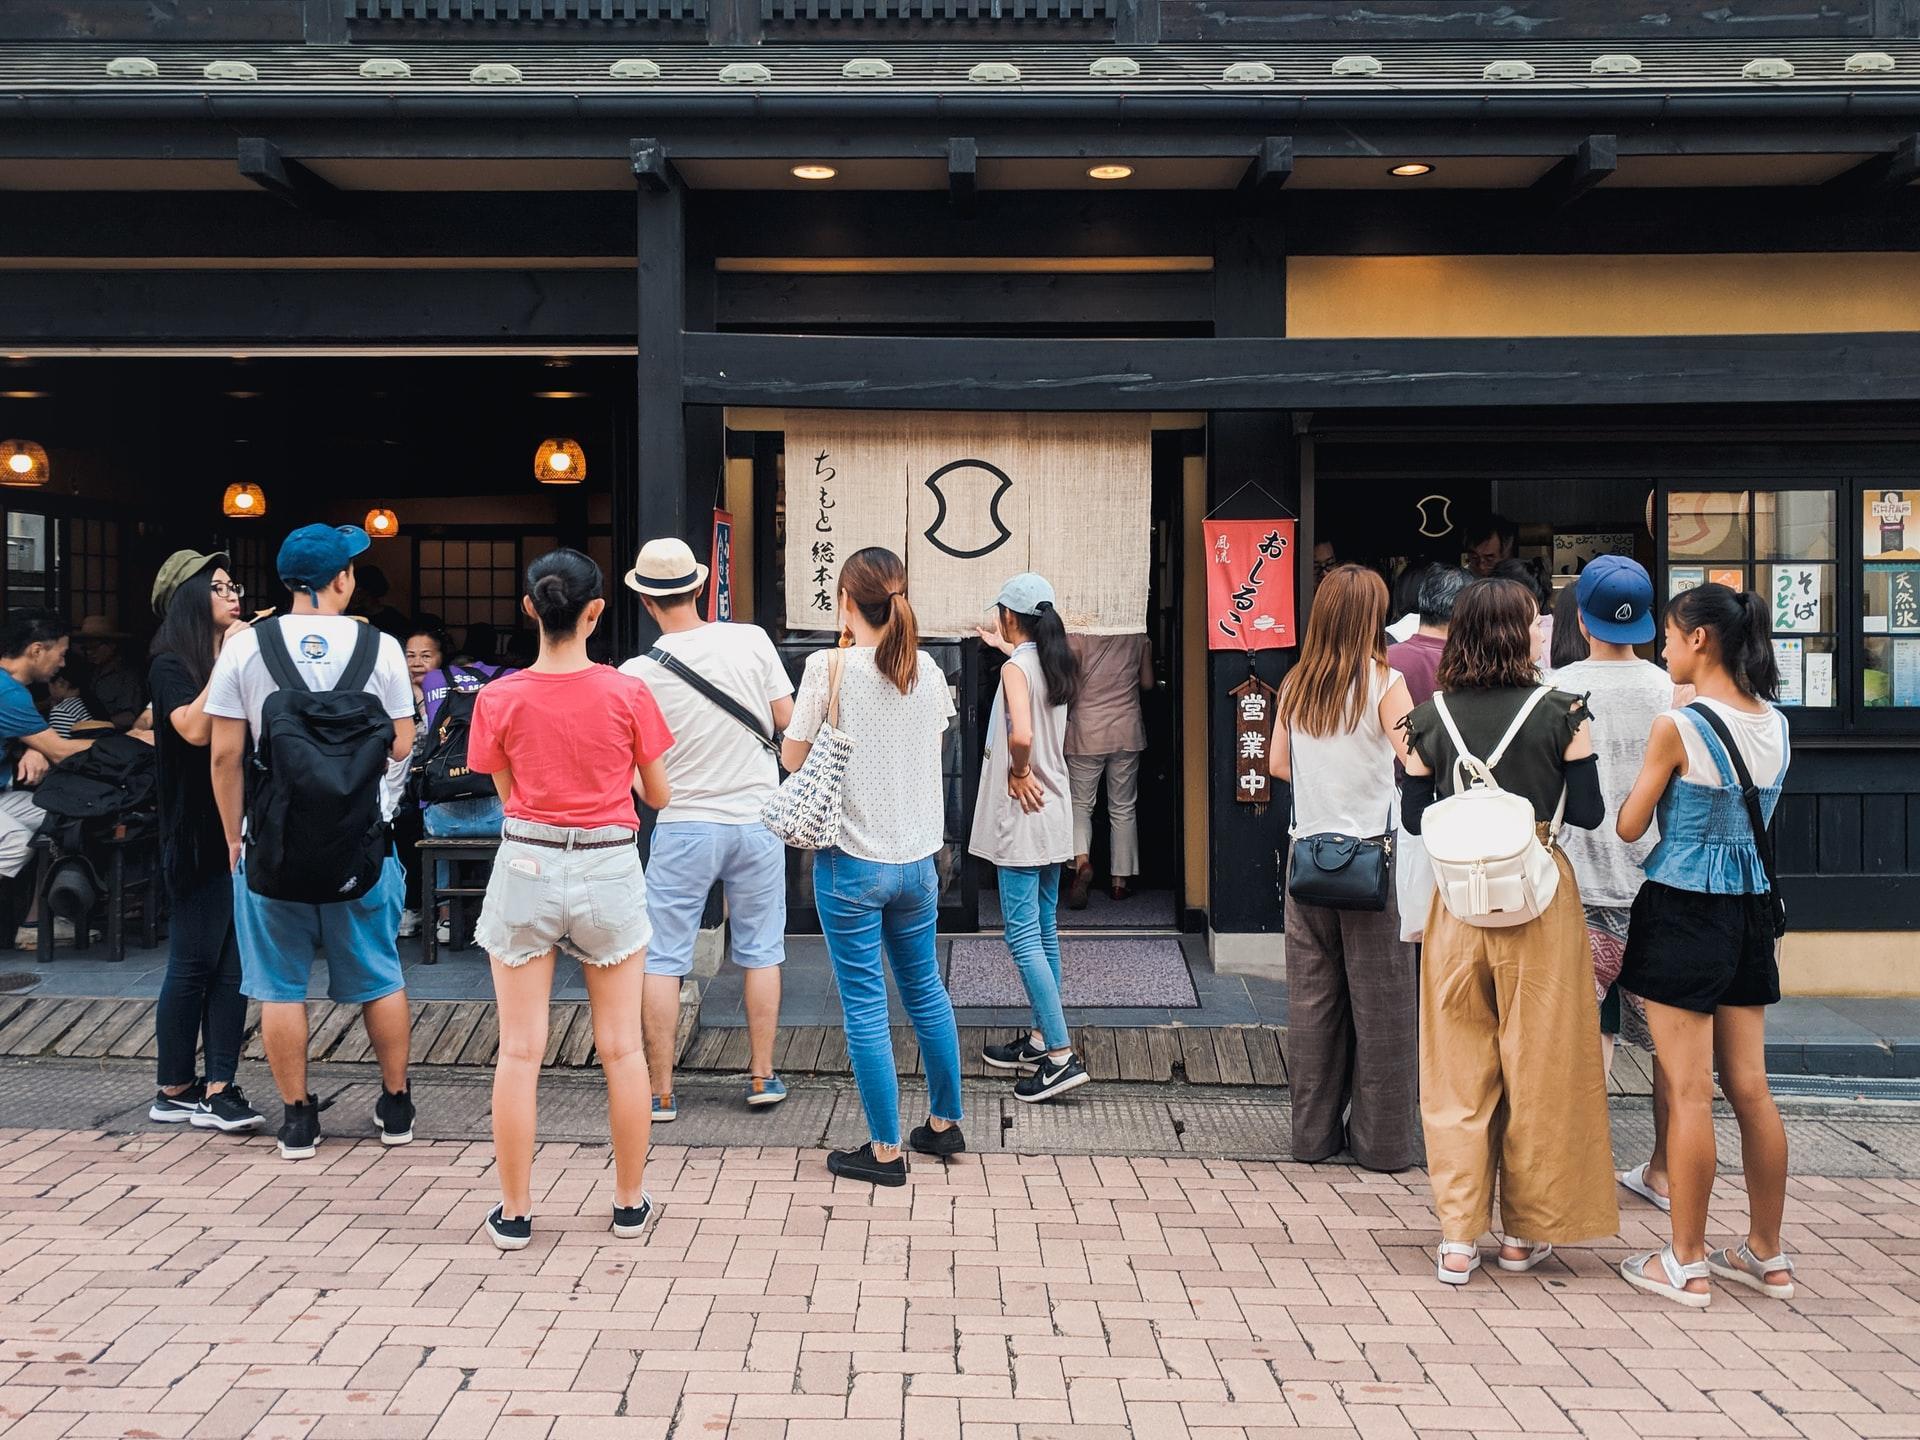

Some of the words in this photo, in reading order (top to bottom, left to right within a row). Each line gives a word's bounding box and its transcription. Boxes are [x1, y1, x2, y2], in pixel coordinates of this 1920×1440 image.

[1215, 534, 1231, 564] 風流
[1219, 530, 1288, 637] おしるこ
[1775, 568, 1796, 629] うどん
[1794, 571, 1818, 621] そば
[1894, 571, 1918, 627] 天然氷
[1240, 693, 1266, 797] 営業中
